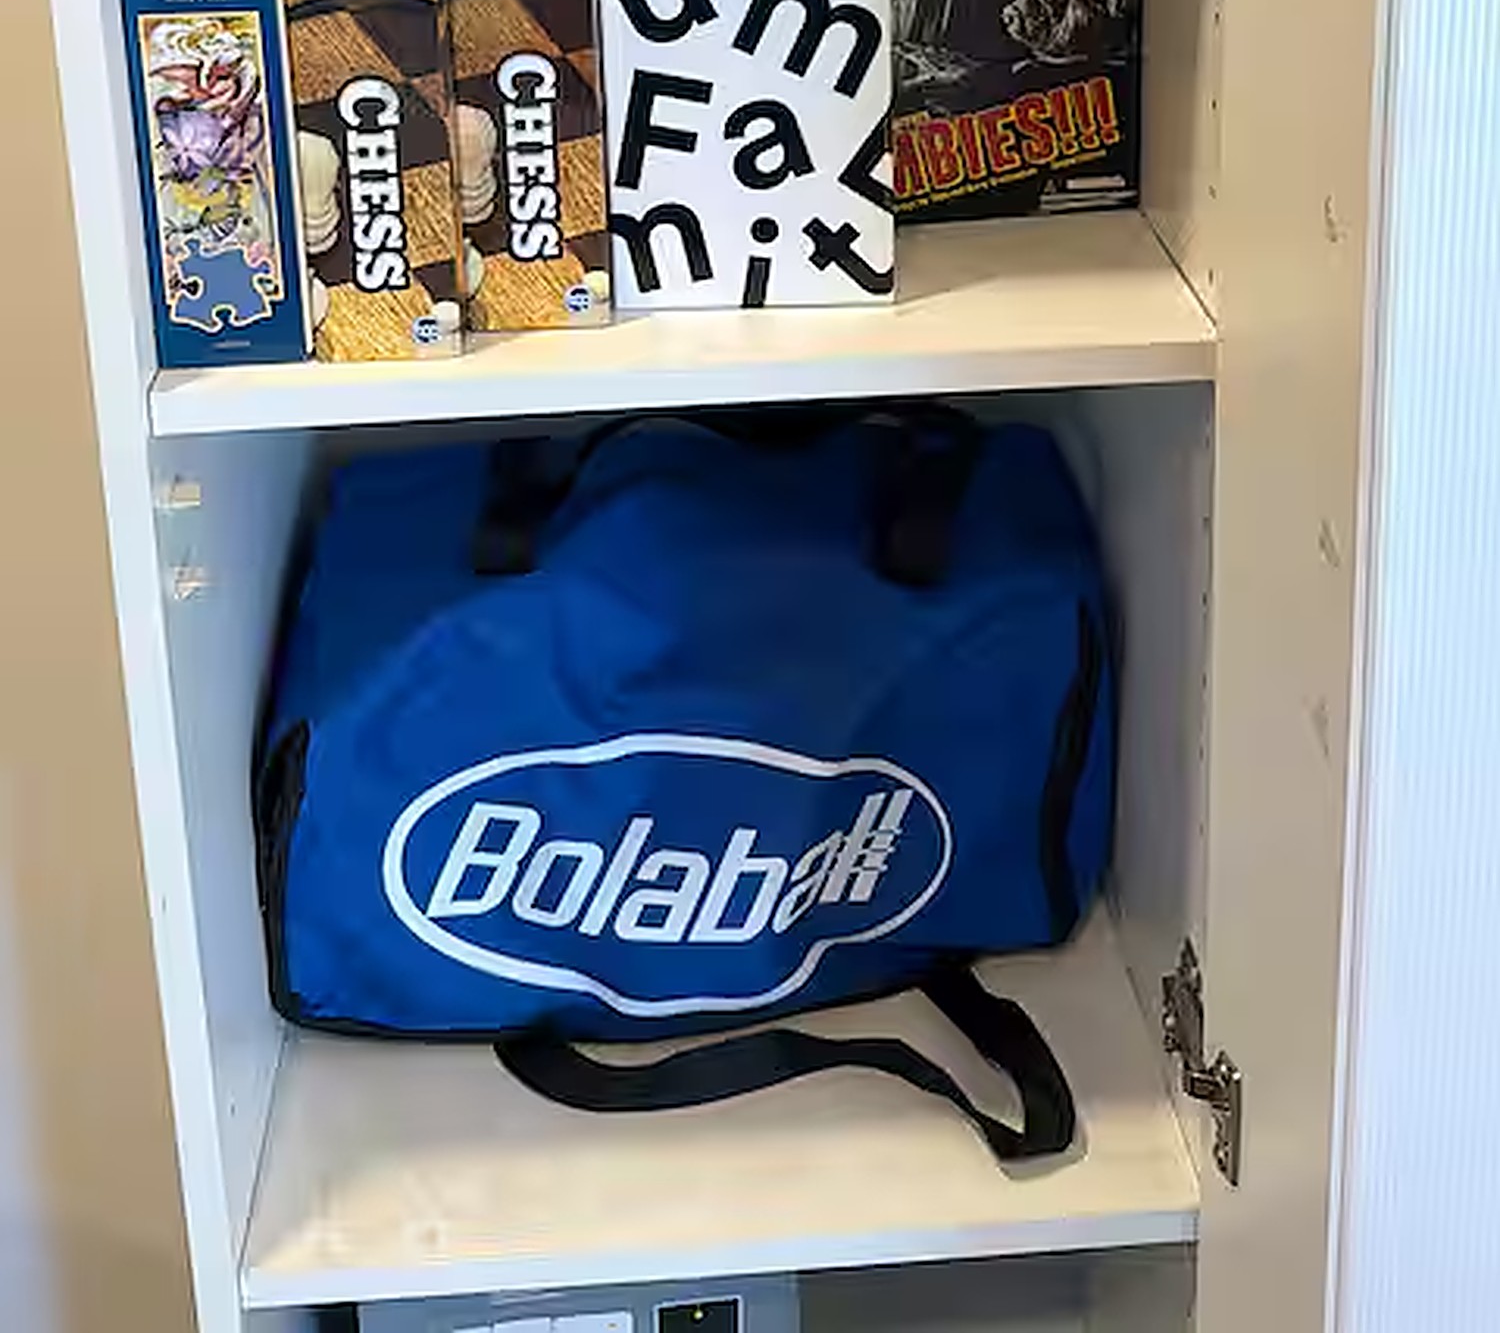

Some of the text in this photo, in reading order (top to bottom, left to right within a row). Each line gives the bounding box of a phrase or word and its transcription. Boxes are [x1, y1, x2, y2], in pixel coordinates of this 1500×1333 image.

[337, 77, 410, 291] CHESS
[498, 53, 562, 260] CHESS
[426, 788, 914, 945] Bolaball
